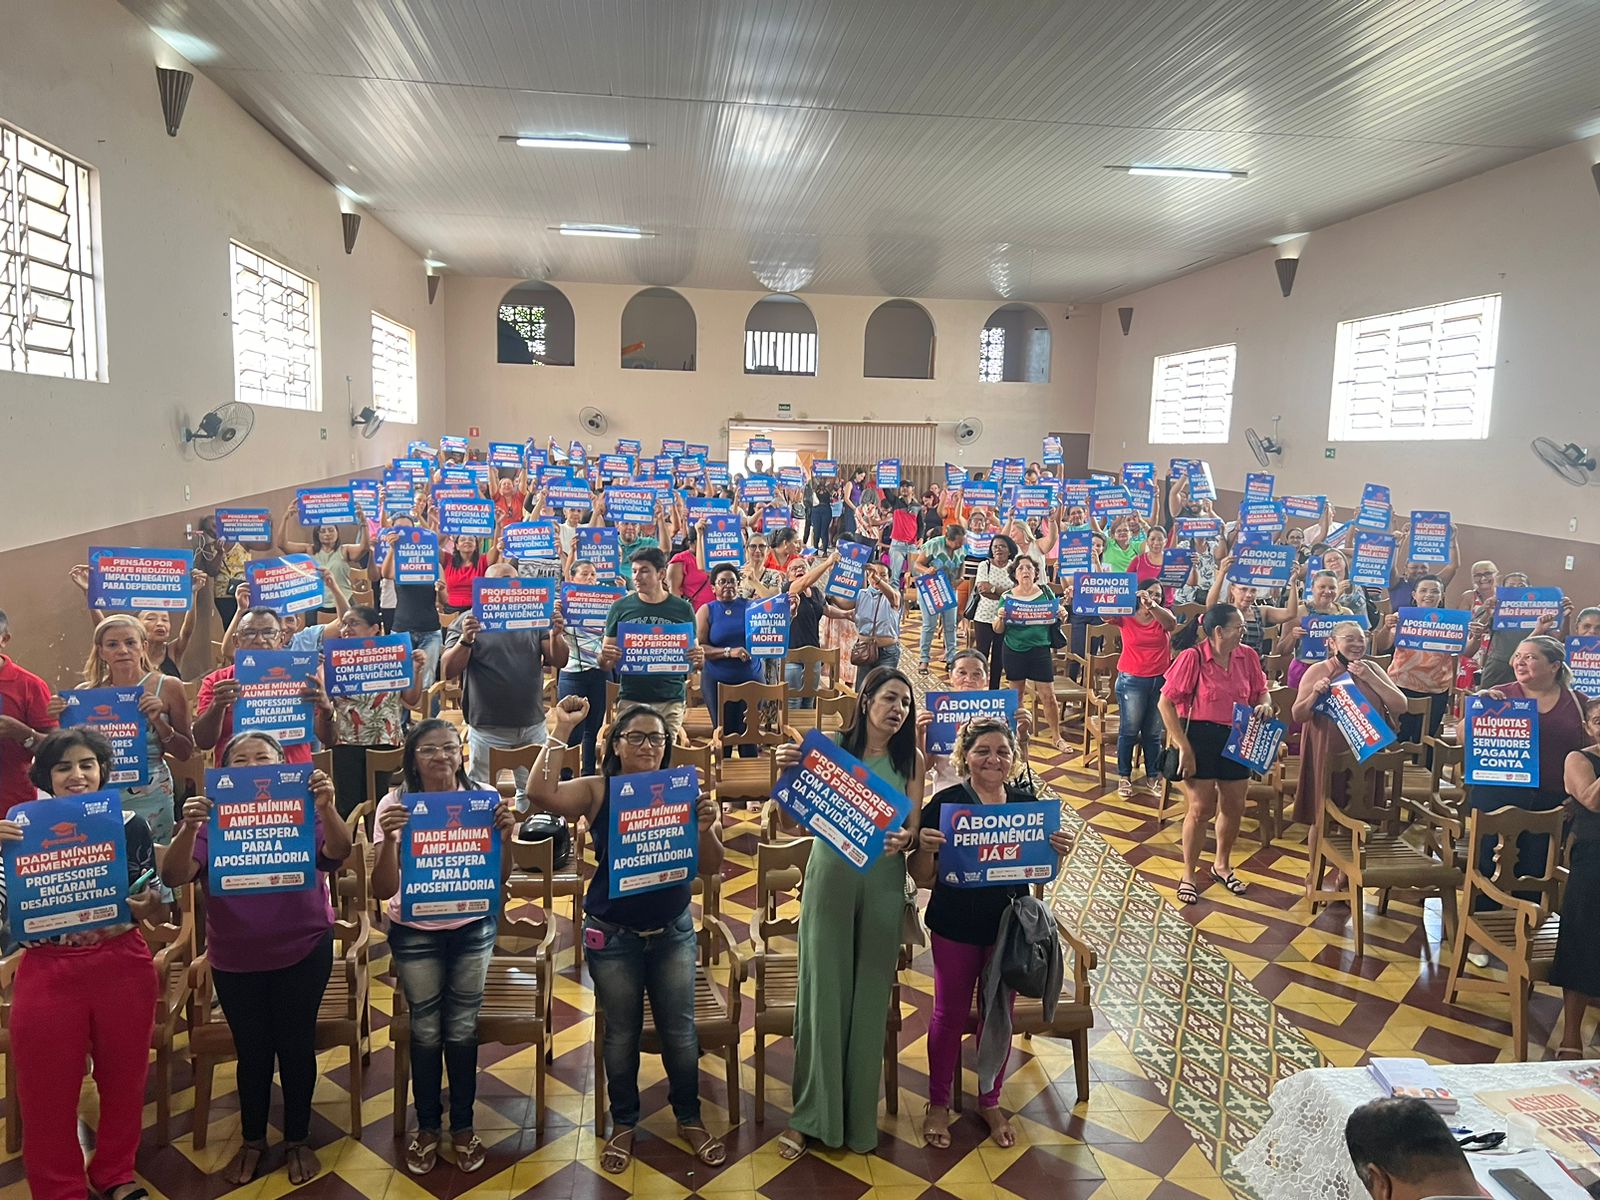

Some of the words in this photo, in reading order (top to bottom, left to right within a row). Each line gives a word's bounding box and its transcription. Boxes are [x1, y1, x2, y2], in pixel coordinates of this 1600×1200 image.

[608, 490, 640, 498] REVOGA
[610, 504, 650, 512] PREVIDÊNCIA
[507, 528, 540, 536] REVOGA
[510, 540, 549, 548] PREVIDÊNCIA
[1360, 544, 1390, 552] ALÍQUOTAS
[1241, 550, 1278, 558] ABONO
[113, 558, 152, 566] PENSÃO
[1238, 557, 1286, 568] PERMANÊNCIA
[135, 567, 185, 575] REDUZIDA:
[1250, 565, 1262, 576] JÁ
[140, 575, 180, 583] NEGATIVO
[102, 582, 125, 590] PARA
[126, 583, 182, 592] DEPENDENTES
[1080, 586, 1130, 594] PERMANÊNCIA
[488, 594, 500, 602] SÓ
[1094, 594, 1106, 604] JÁ
[508, 602, 544, 610] REFORMA
[1498, 608, 1514, 616] NÃO
[494, 608, 544, 618] PREVIDÊNCIA
[750, 619, 786, 627] TRABALHAR
[1402, 619, 1464, 631] APOSENTADORIA
[760, 626, 771, 634] ATÉ
[1400, 626, 1418, 635] NÃO
[1423, 628, 1464, 639] PRIVILÉGIO
[625, 633, 687, 641] PROFESSORES
[632, 639, 644, 648] SÓ
[332, 645, 404, 658] PROFESSORES
[340, 655, 356, 665] SÓ
[356, 654, 398, 664] PERDEM
[636, 654, 684, 662] PREVIDÊNCIA
[336, 664, 355, 674] COM
[355, 664, 362, 673] A
[362, 660, 403, 672] REFORMA
[336, 674, 348, 682] DA
[348, 668, 404, 682] PREVIDÊNCIA
[271, 680, 307, 689] MÍNIMA
[246, 697, 302, 708] PROFESSORES
[938, 698, 991, 710] ABONO
[992, 698, 1006, 709] DE
[254, 706, 294, 716] ENCARAM
[1337, 684, 1380, 741] PROFESSORES
[241, 715, 278, 726] DESAFIOS
[278, 713, 306, 722] EXTRAS
[1343, 706, 1370, 738] PERDEM
[1476, 716, 1528, 728] ALÍQUOTAS
[1473, 728, 1497, 738] MAIS
[1498, 729, 1530, 738] ALTAS:
[1472, 738, 1530, 749] SERVIDORES
[1473, 749, 1518, 758] PAGAM
[1520, 750, 1530, 759] A
[1480, 759, 1524, 768] CONTA
[810, 749, 895, 818] PROFESSORES
[813, 764, 832, 781] SÓ
[830, 778, 880, 820] PERDEM
[220, 804, 256, 816] IDADE
[258, 800, 302, 813] MÍNIMA
[800, 769, 823, 792] COM
[820, 788, 830, 798] A
[828, 792, 876, 836] REFORMA
[620, 809, 650, 822] IDADE
[651, 804, 688, 818] MÍNIMA
[792, 779, 806, 796] DA
[806, 790, 868, 847] PREVIDÊNCIA
[229, 814, 294, 828] AMPLIADA:
[627, 816, 681, 832] AMPLIADA:
[956, 814, 1026, 830] ABONO
[1026, 812, 1044, 826] DE
[224, 829, 254, 841] MAIS
[256, 826, 299, 838] ESPERA
[414, 831, 446, 843] IDADE
[448, 828, 488, 840] MÍNIMA
[622, 831, 647, 844] MAIS
[648, 826, 684, 840] ESPERA
[954, 828, 1044, 847] PERMANÊNCIA
[242, 841, 274, 852] PARA
[274, 840, 283, 851] A
[421, 841, 482, 855] AMPLIADA:
[636, 841, 663, 854] PARA
[663, 840, 671, 851] A
[16, 852, 59, 866] IDADE
[60, 842, 113, 859] MÍNIMA
[214, 851, 310, 868] APOSENTADORIA
[613, 848, 694, 870] APOSENTADORIA
[980, 846, 1001, 862] JÁ
[20, 854, 111, 876] AUMENTADA:
[416, 858, 444, 868] MAIS
[445, 854, 486, 867] ESPERA
[26, 866, 108, 888] PROFESSORES
[432, 868, 461, 880] PARA
[462, 868, 470, 878] A
[40, 879, 96, 898] ENCARAM
[406, 878, 496, 894] APOSENTADORIA
[20, 894, 74, 911] DESAFIOS
[75, 886, 117, 902] EXTRAS
[1506, 1093, 1581, 1112] ASSÉDIO
[1523, 1108, 1600, 1128] NUNCA
